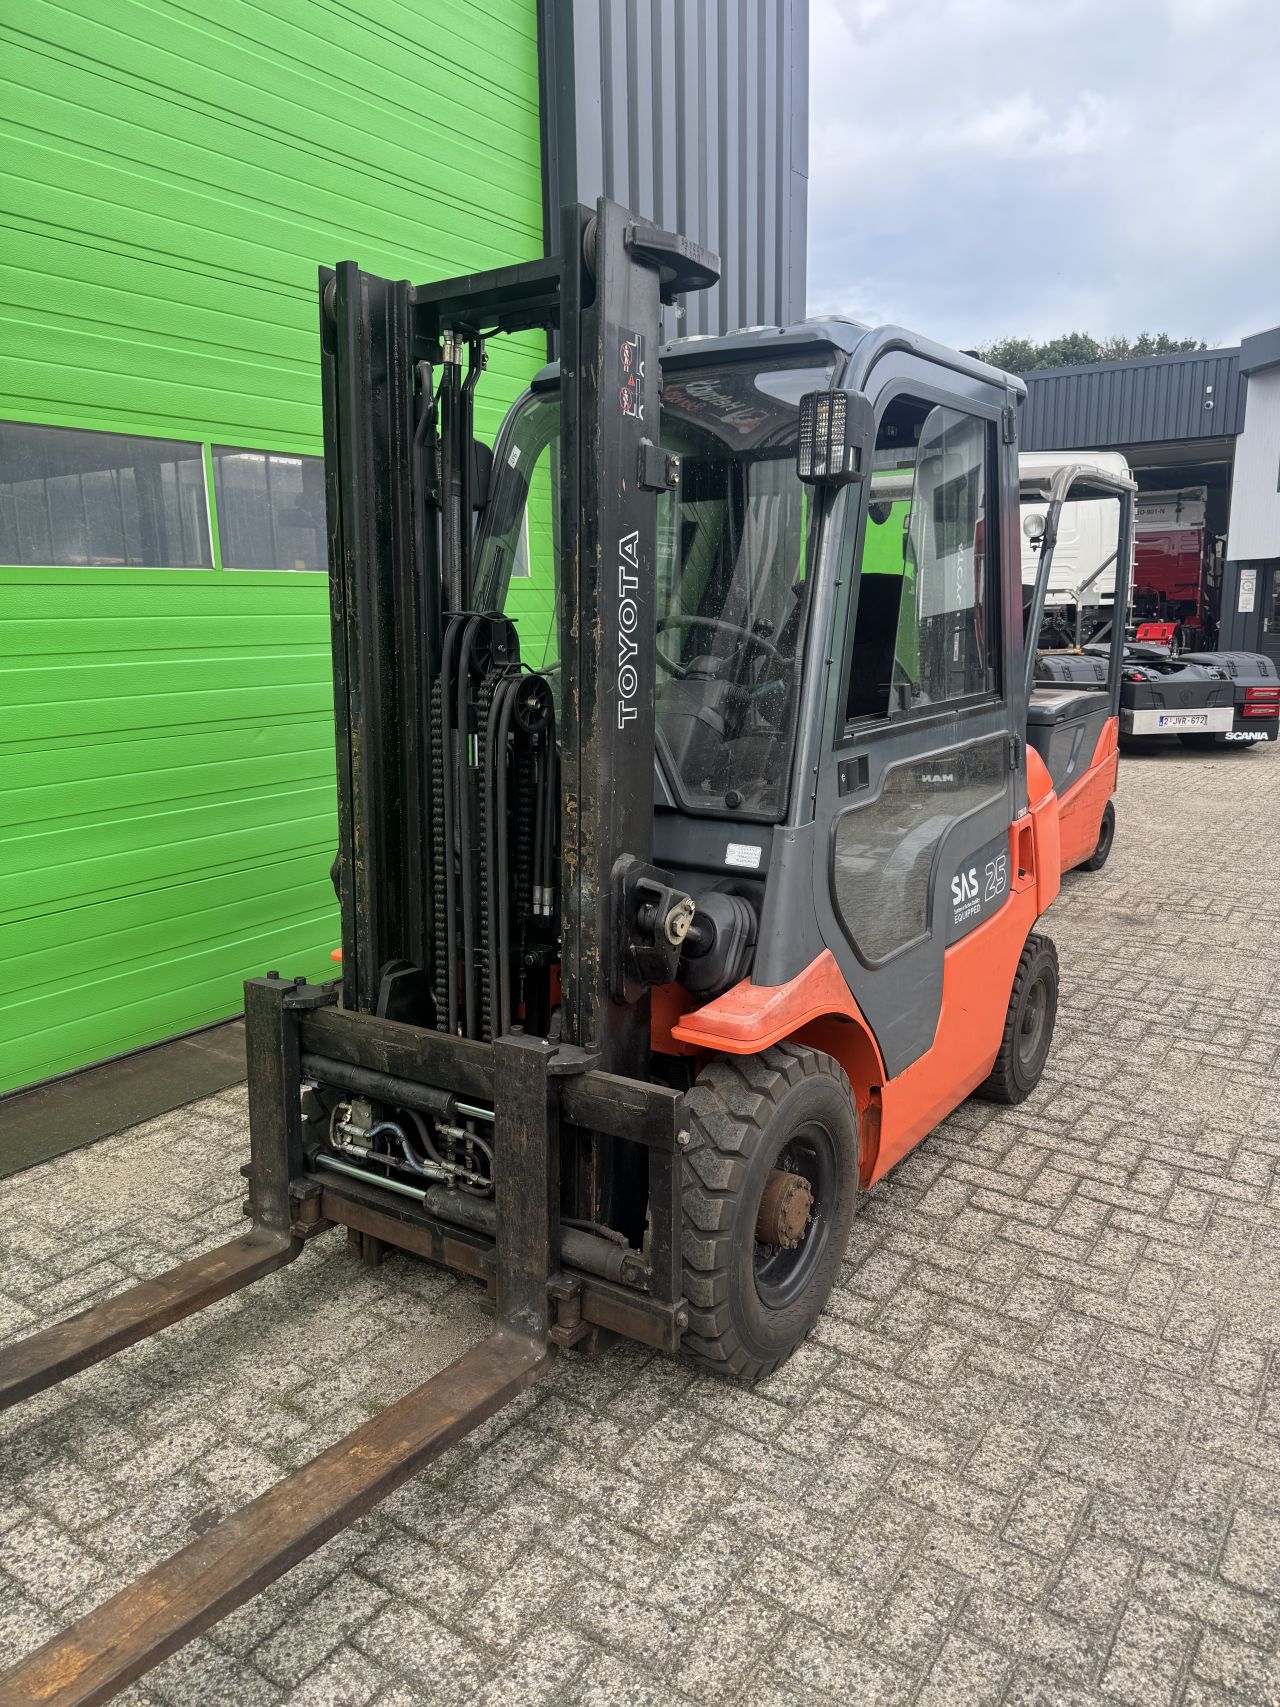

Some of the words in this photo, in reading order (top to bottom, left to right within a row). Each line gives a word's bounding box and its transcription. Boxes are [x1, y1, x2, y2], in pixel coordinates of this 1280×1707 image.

[618, 531, 640, 729] TOYOTA
[1225, 732, 1268, 741] SCANIA
[951, 867, 979, 906] SAS
[985, 855, 1006, 902] 25
[954, 904, 981, 924] EQUIPPED
